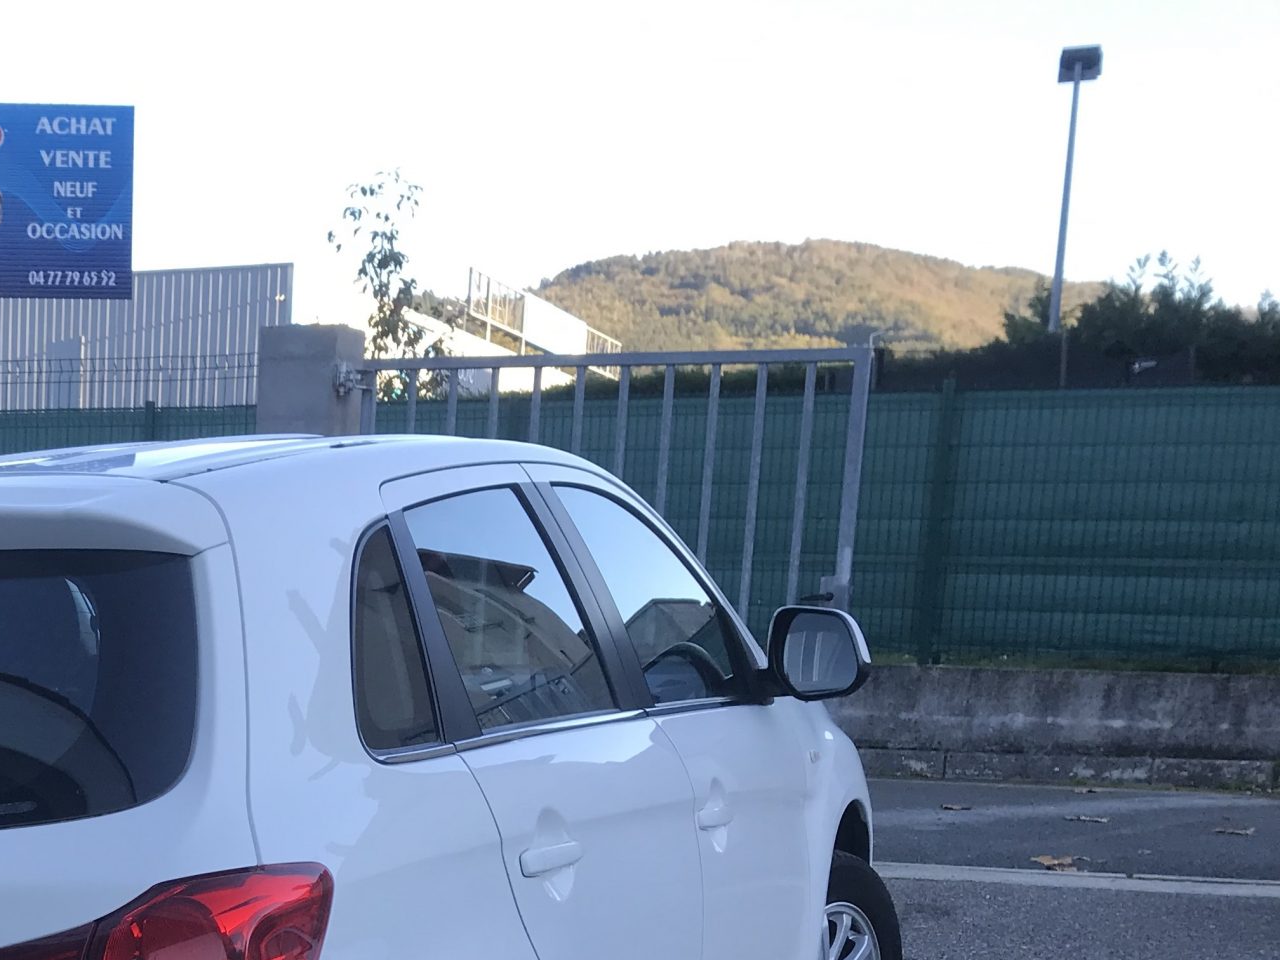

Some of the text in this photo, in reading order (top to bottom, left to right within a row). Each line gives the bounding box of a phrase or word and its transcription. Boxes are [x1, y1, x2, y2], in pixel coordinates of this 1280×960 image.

[35, 116, 116, 135] ACHAT
[40, 149, 112, 168] VENTE
[53, 181, 97, 198] NEUF
[67, 207, 83, 219] ET
[27, 222, 123, 240] OCCASION
[28, 270, 44, 286] 04
[47, 271, 62, 286] 77
[65, 271, 80, 286] 79
